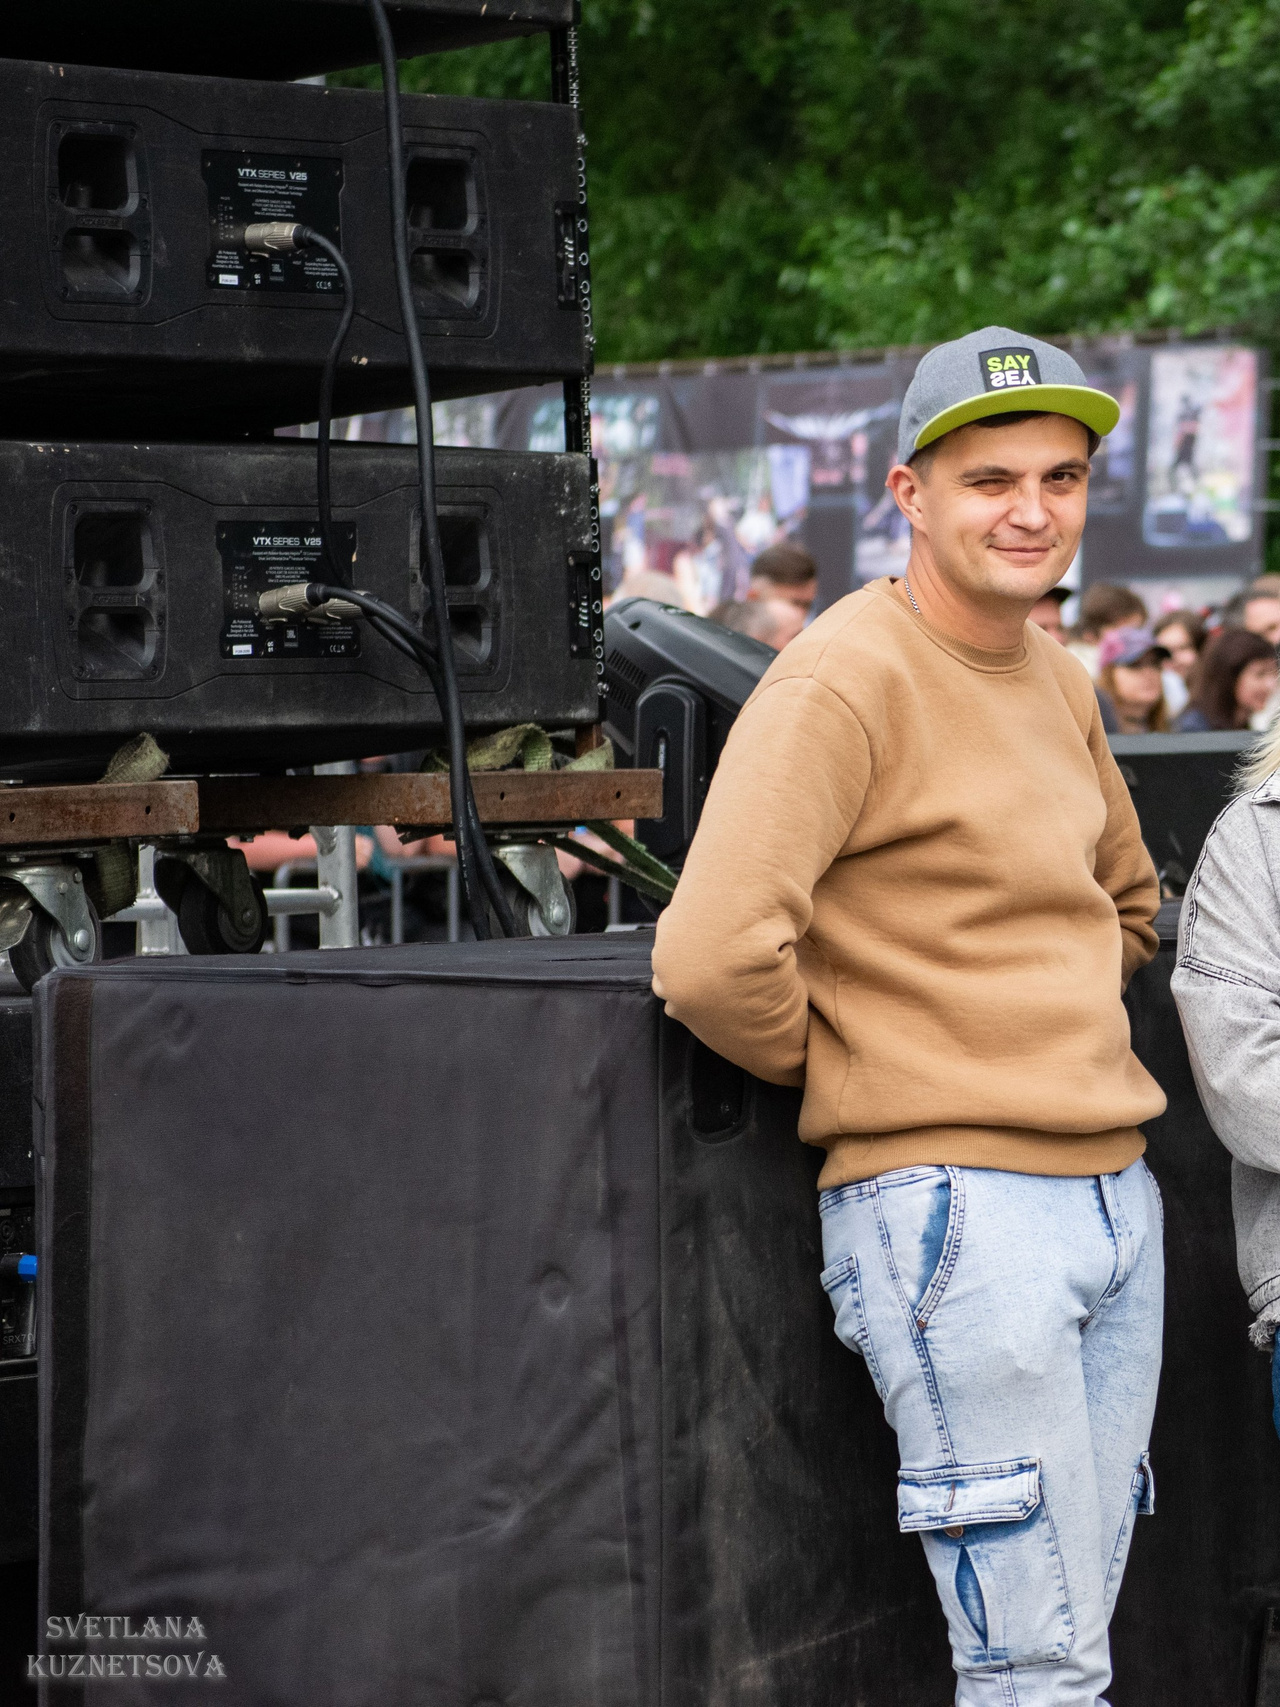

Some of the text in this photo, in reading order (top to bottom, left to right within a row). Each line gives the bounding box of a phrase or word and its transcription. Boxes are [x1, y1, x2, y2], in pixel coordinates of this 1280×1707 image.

[237, 168, 308, 181] VTX SERIES V25
[987, 354, 1030, 372] SAY
[252, 536, 322, 546] VTX SERIES V25
